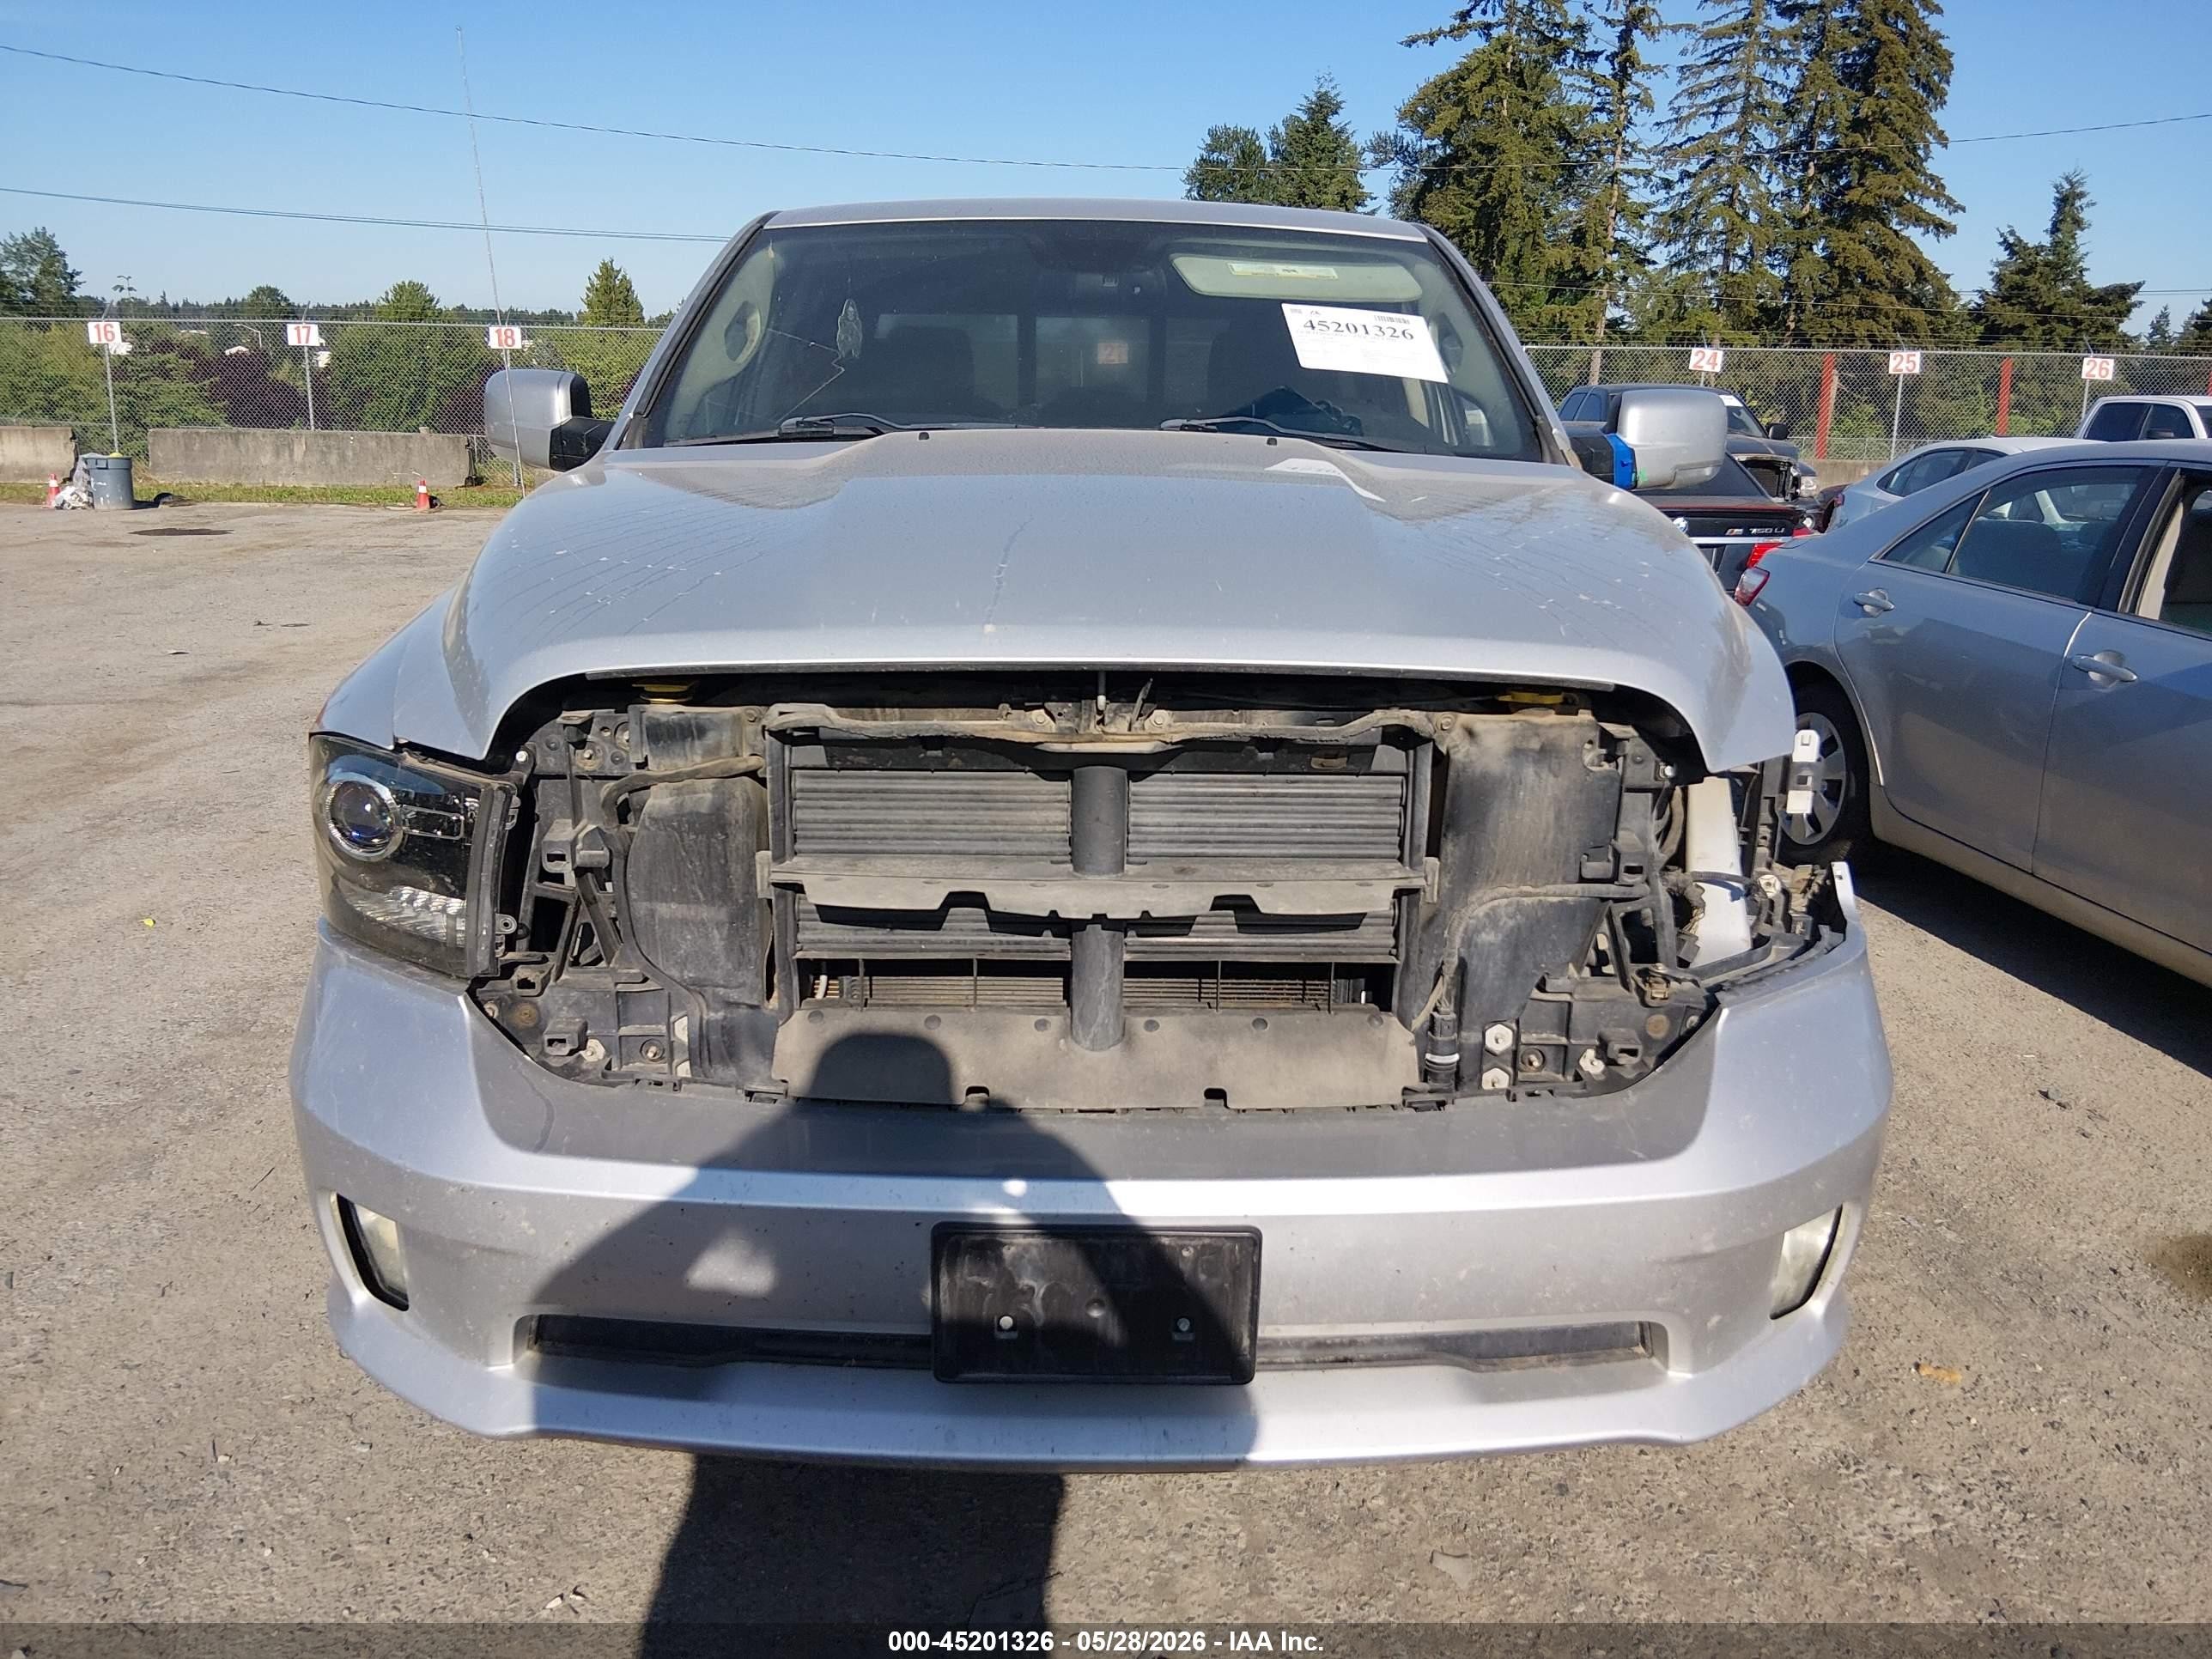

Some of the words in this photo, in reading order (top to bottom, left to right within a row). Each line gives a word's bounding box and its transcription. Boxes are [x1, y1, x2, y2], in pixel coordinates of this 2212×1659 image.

[94, 324, 115, 343] 16
[295, 326, 311, 344] 17
[495, 328, 515, 347] 18
[1303, 319, 1415, 341] 45201326
[1693, 349, 1717, 370] 24
[1893, 354, 1916, 373] 25
[2085, 360, 2110, 379] 26
